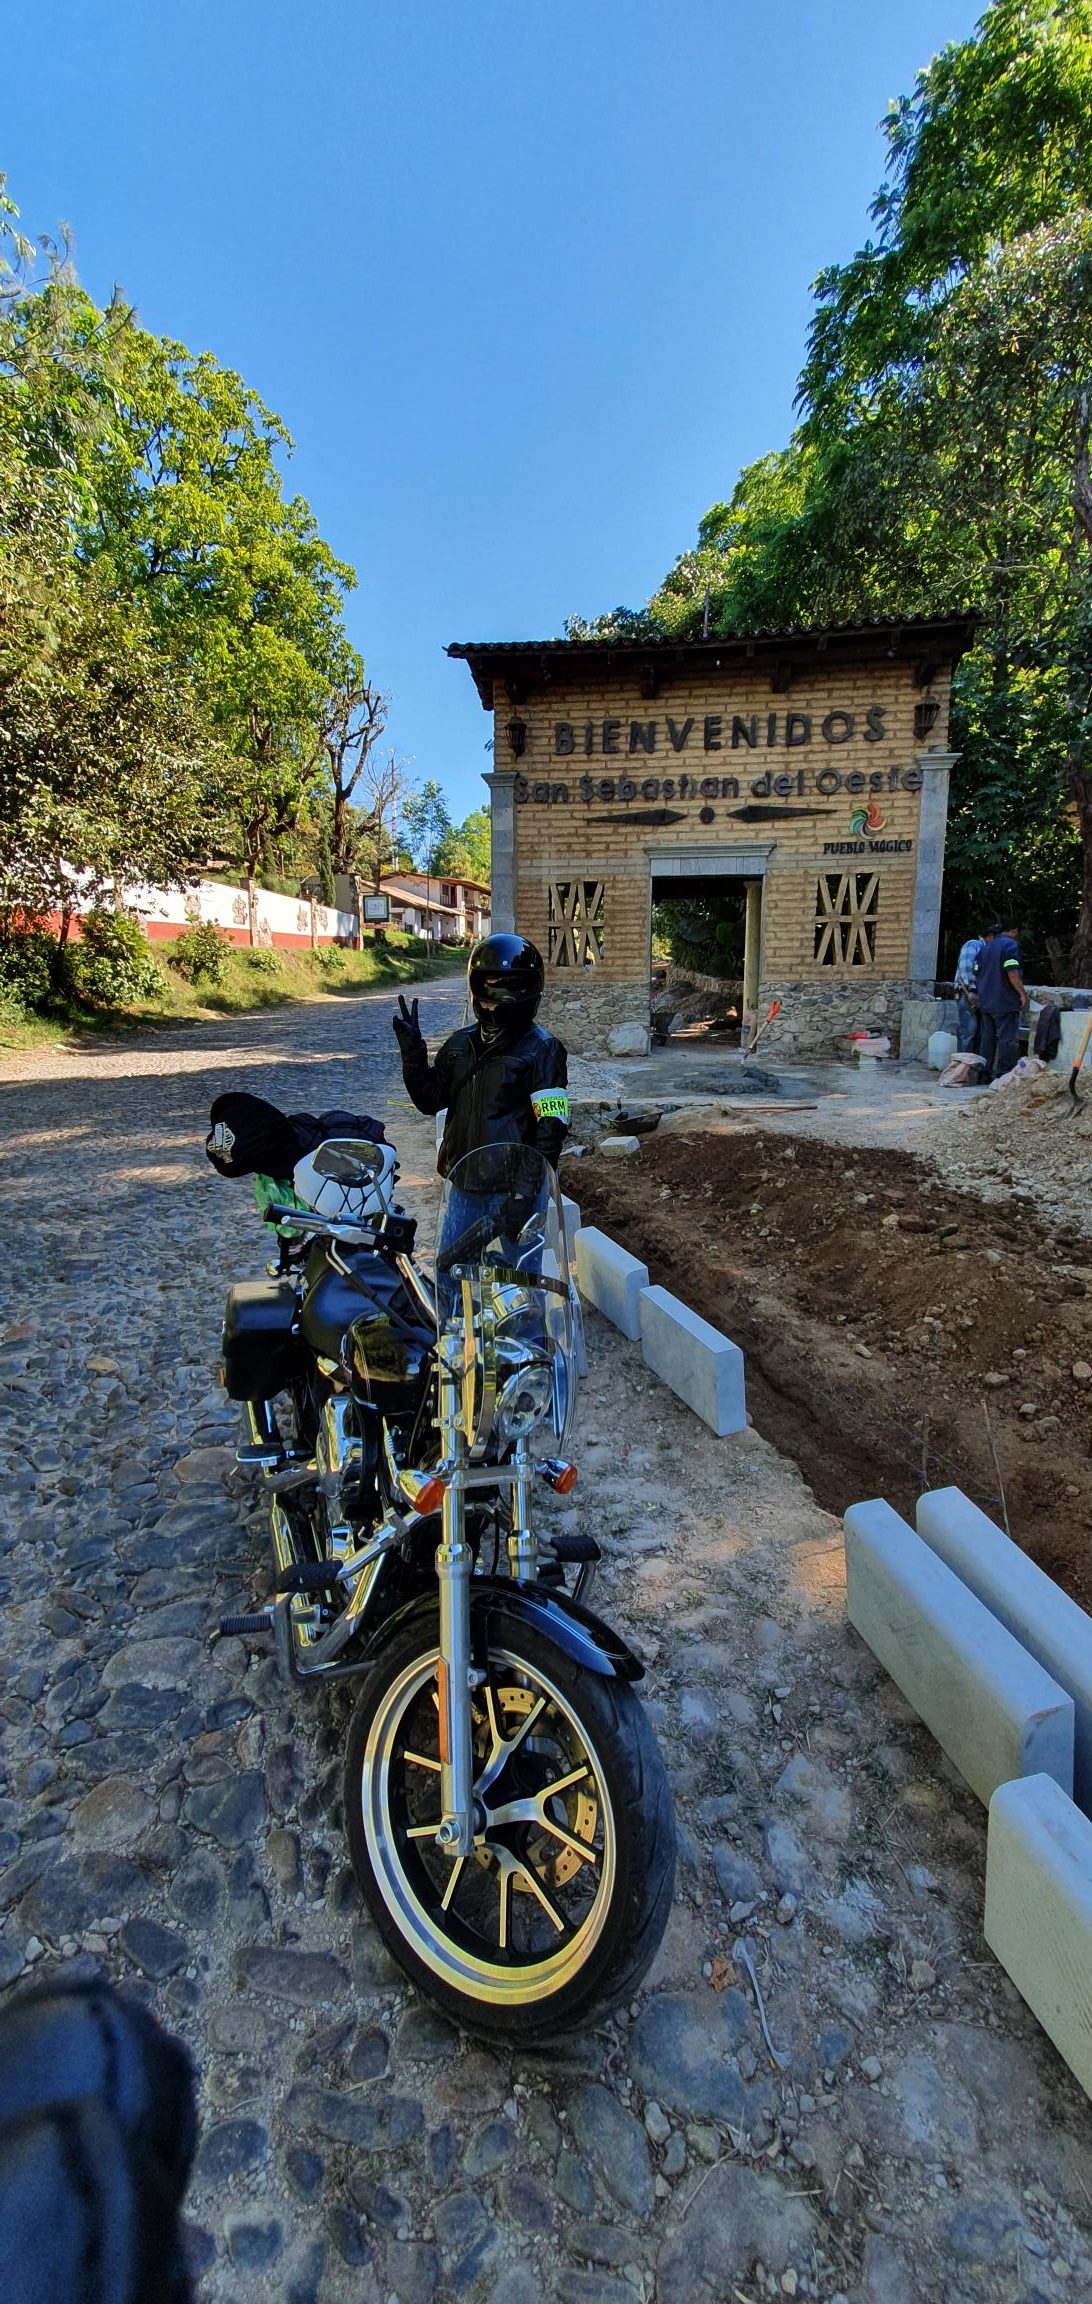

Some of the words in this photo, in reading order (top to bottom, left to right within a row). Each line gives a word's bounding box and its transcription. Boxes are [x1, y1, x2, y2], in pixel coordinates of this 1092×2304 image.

[554, 705, 886, 755] BIENVENIDOS
[513, 775, 569, 803] San
[751, 768, 805, 798] del
[816, 766, 923, 796] Oeste
[823, 841, 865, 855] PUEBLO
[541, 1100, 566, 1112] RRM
